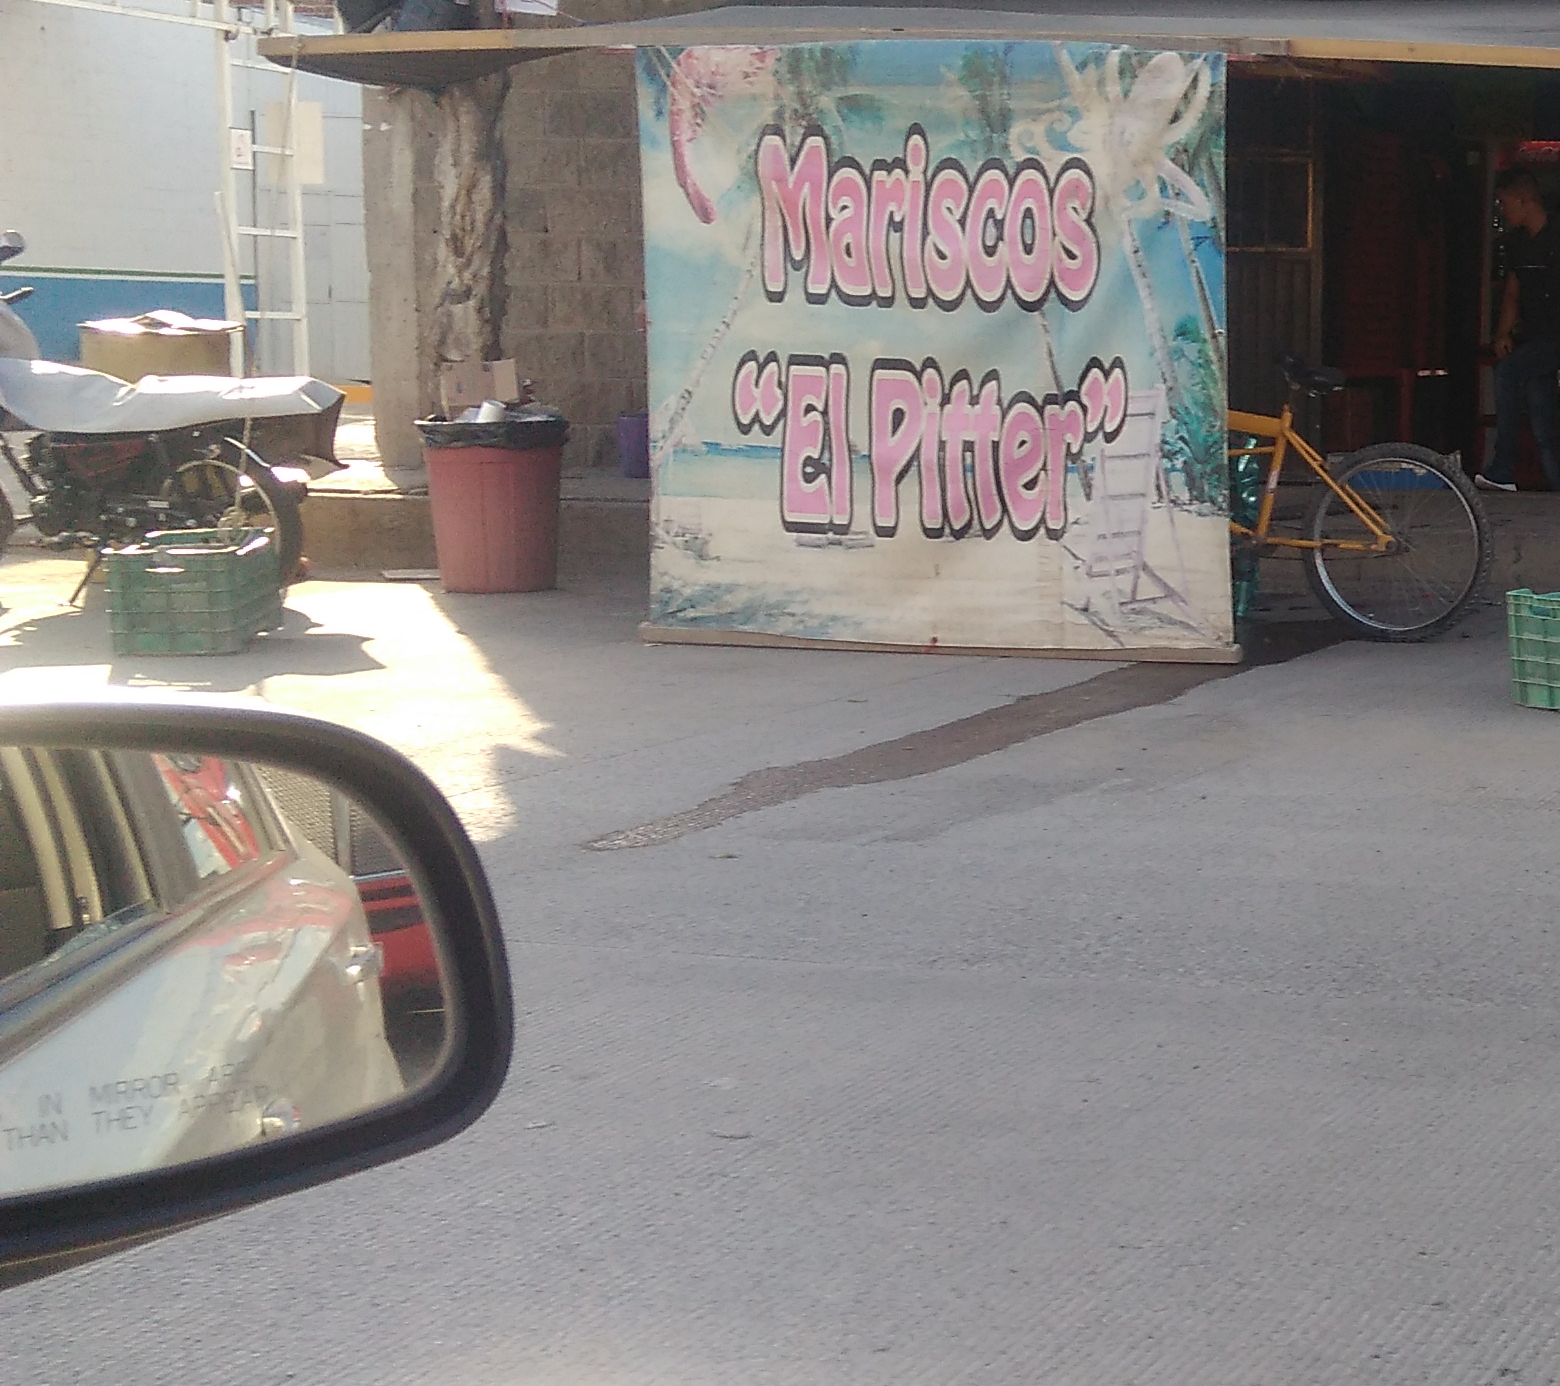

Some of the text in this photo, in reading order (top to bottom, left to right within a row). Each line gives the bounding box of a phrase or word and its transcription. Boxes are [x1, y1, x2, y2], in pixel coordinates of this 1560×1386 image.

[755, 122, 1101, 313] Mariscos
[89, 1071, 180, 1105] MIRROR
[2, 1119, 69, 1151] THAN
[91, 1104, 154, 1135] THEY
